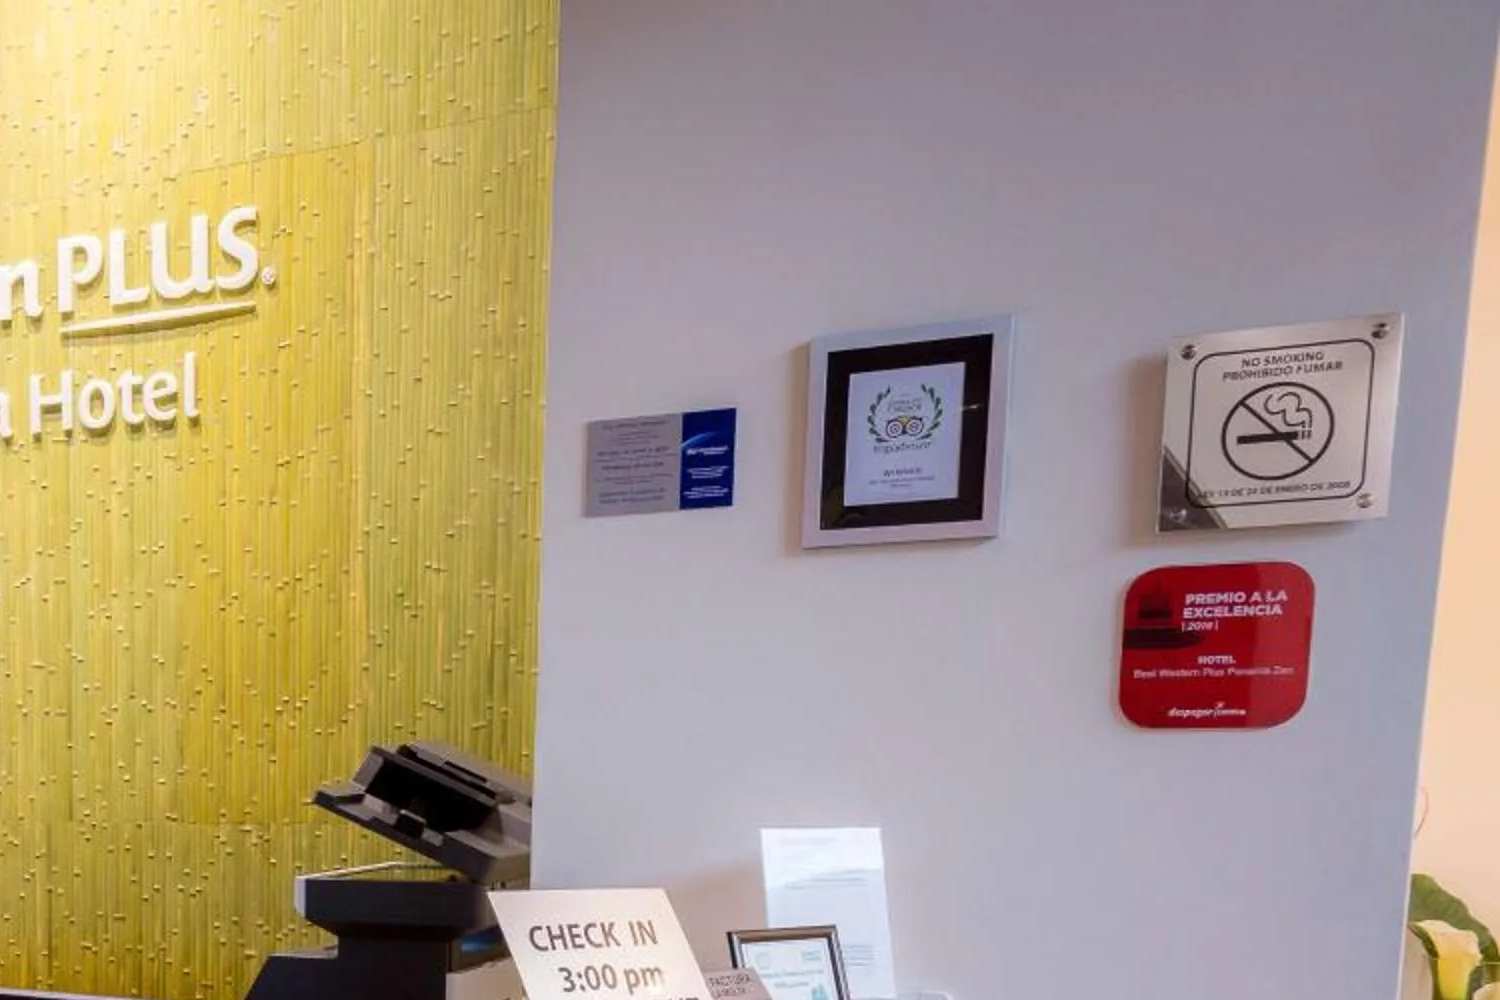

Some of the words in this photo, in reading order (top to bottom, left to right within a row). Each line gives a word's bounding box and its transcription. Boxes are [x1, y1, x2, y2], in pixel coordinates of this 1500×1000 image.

[1241, 357, 1261, 369] NO
[1263, 351, 1325, 366] SMOKING
[1222, 365, 1293, 382] PROHIBIDO
[1296, 361, 1343, 375] FUMAR
[28, 352, 200, 436] Hotel
[1185, 592, 1247, 605] PREMIO
[1249, 590, 1263, 602] A
[1265, 589, 1288, 602] LA
[1183, 604, 1283, 619] EXCELENCIA
[1198, 655, 1237, 664] HOTEL
[529, 921, 621, 951] CHECK
[628, 919, 659, 947] IN
[558, 964, 618, 993] 3:00
[624, 966, 666, 995] pm
